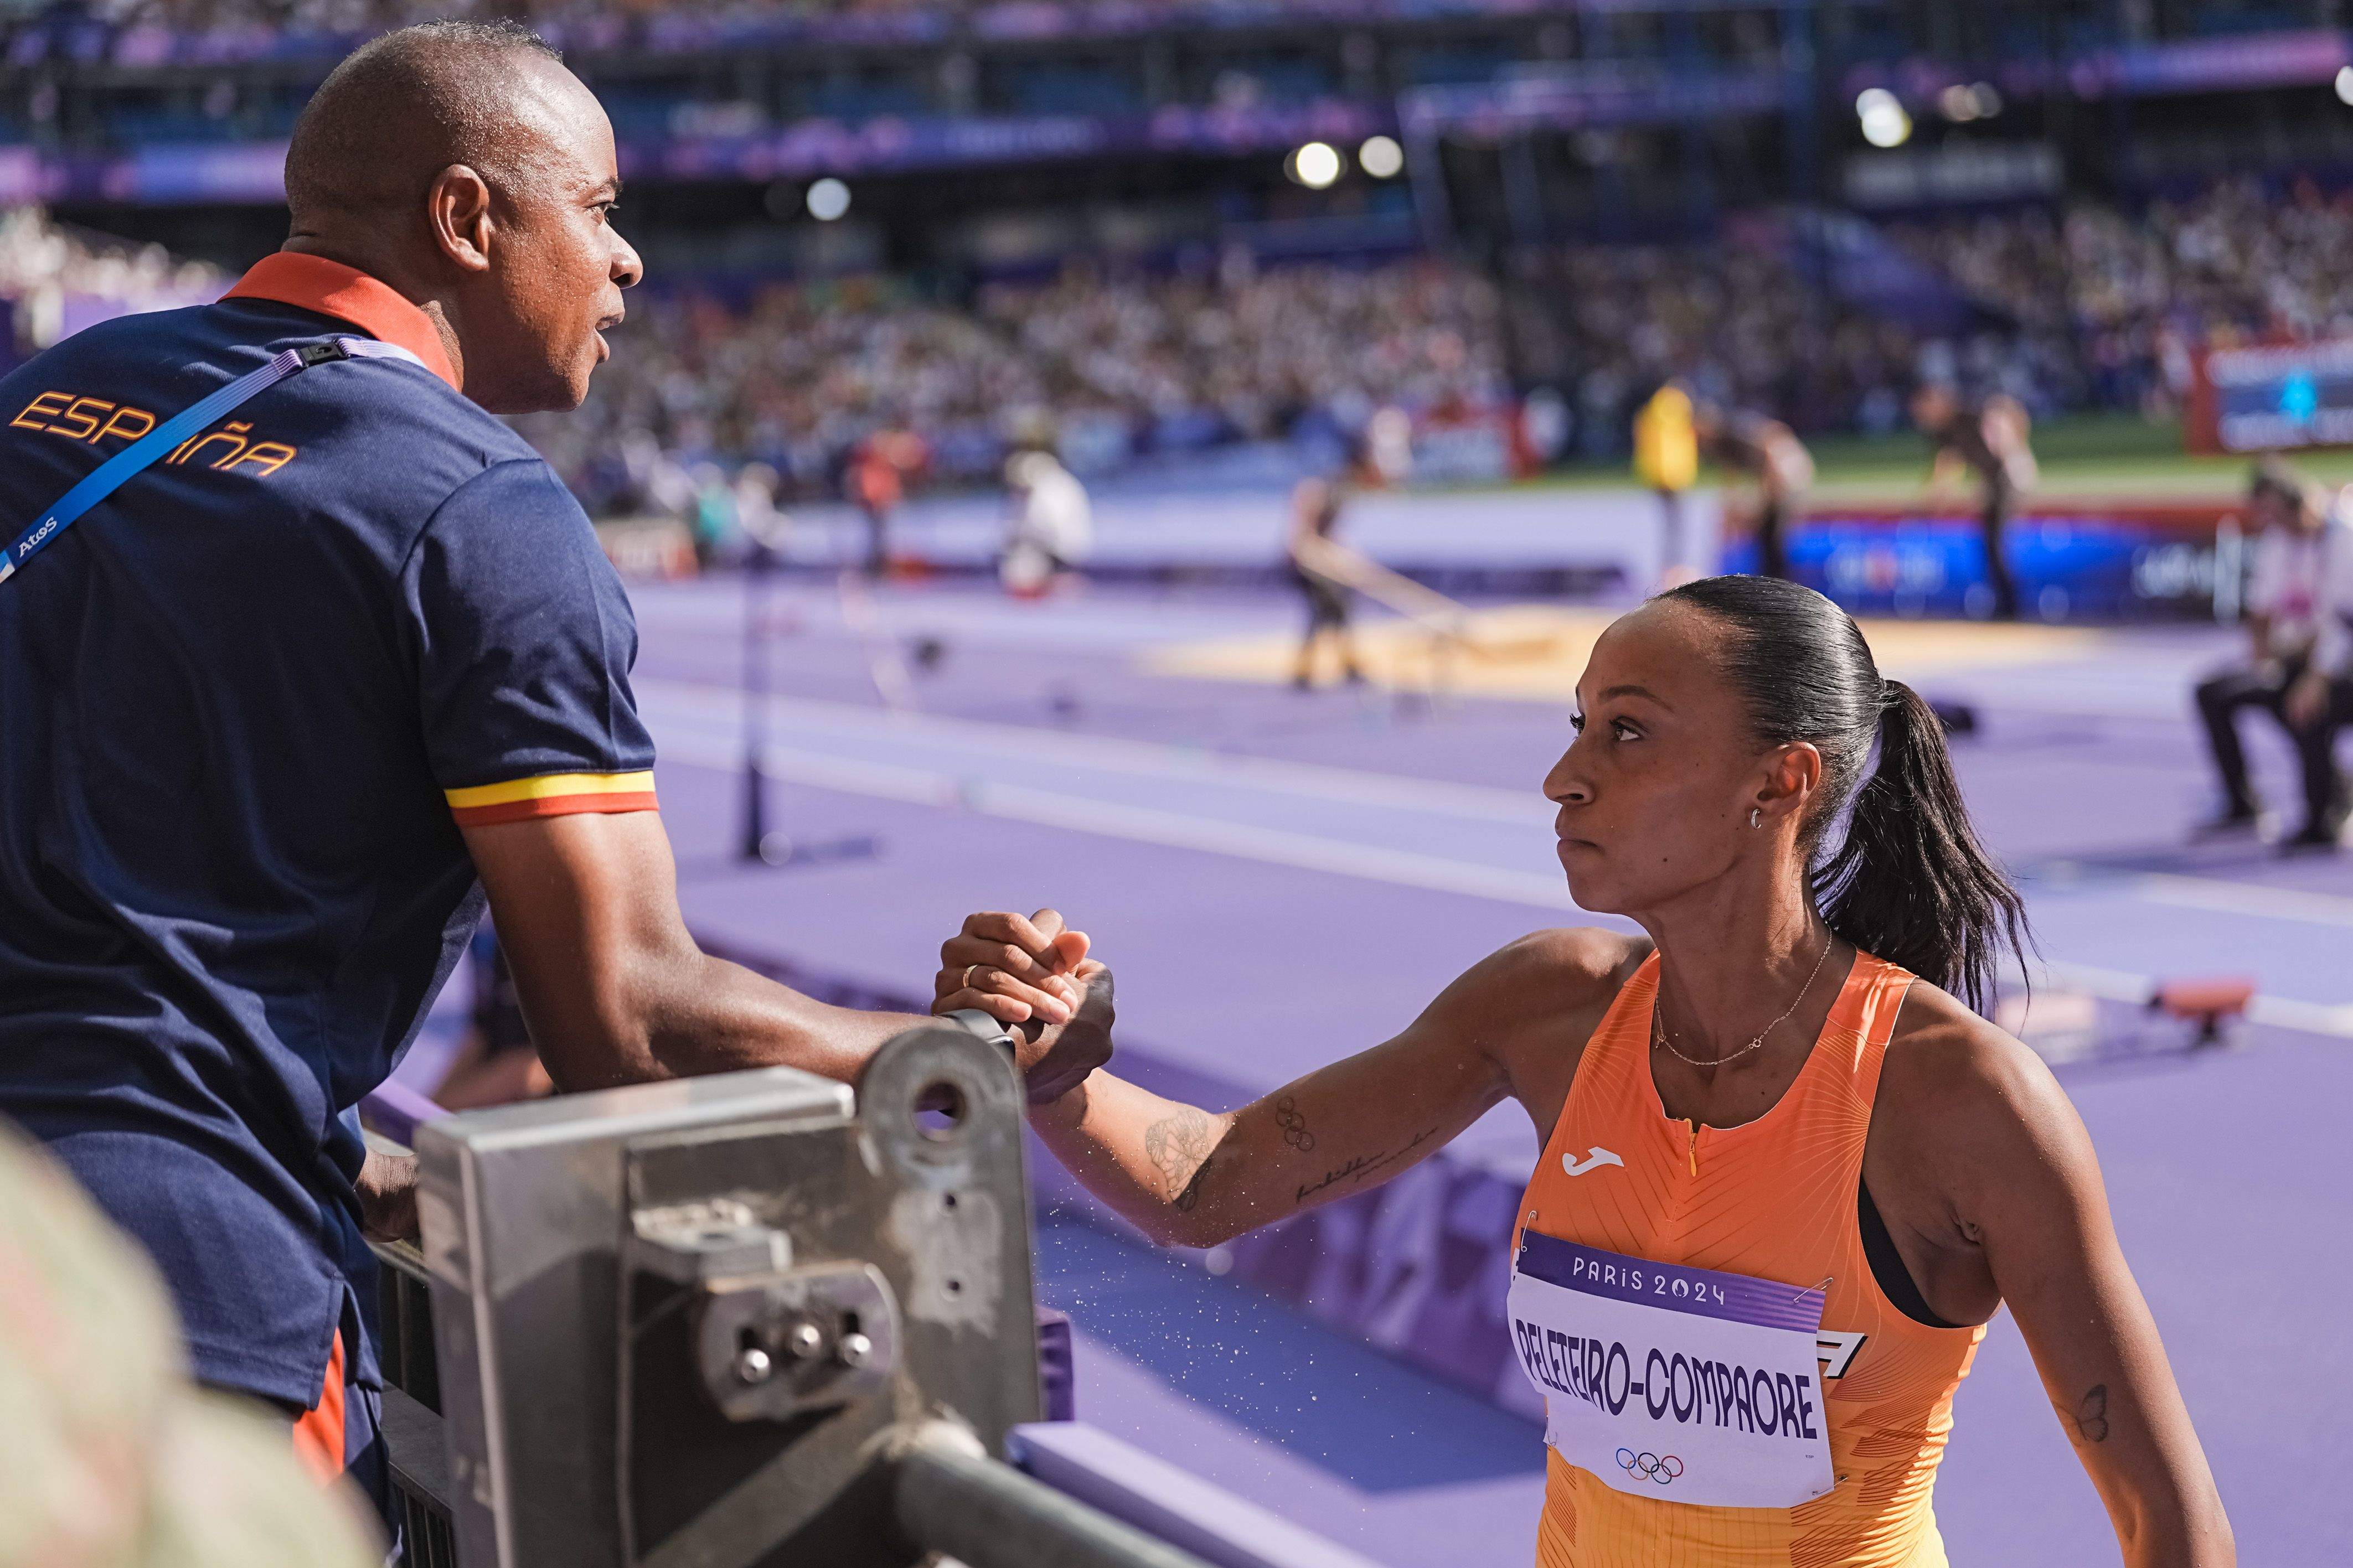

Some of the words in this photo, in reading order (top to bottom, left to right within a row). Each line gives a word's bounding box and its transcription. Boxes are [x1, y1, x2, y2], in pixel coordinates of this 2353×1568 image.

[8, 390, 297, 477] ESPÑA
[1654, 1275, 1724, 1305] 2024
[1515, 1318, 1818, 1439] PELETEIRO-COMPAORE
